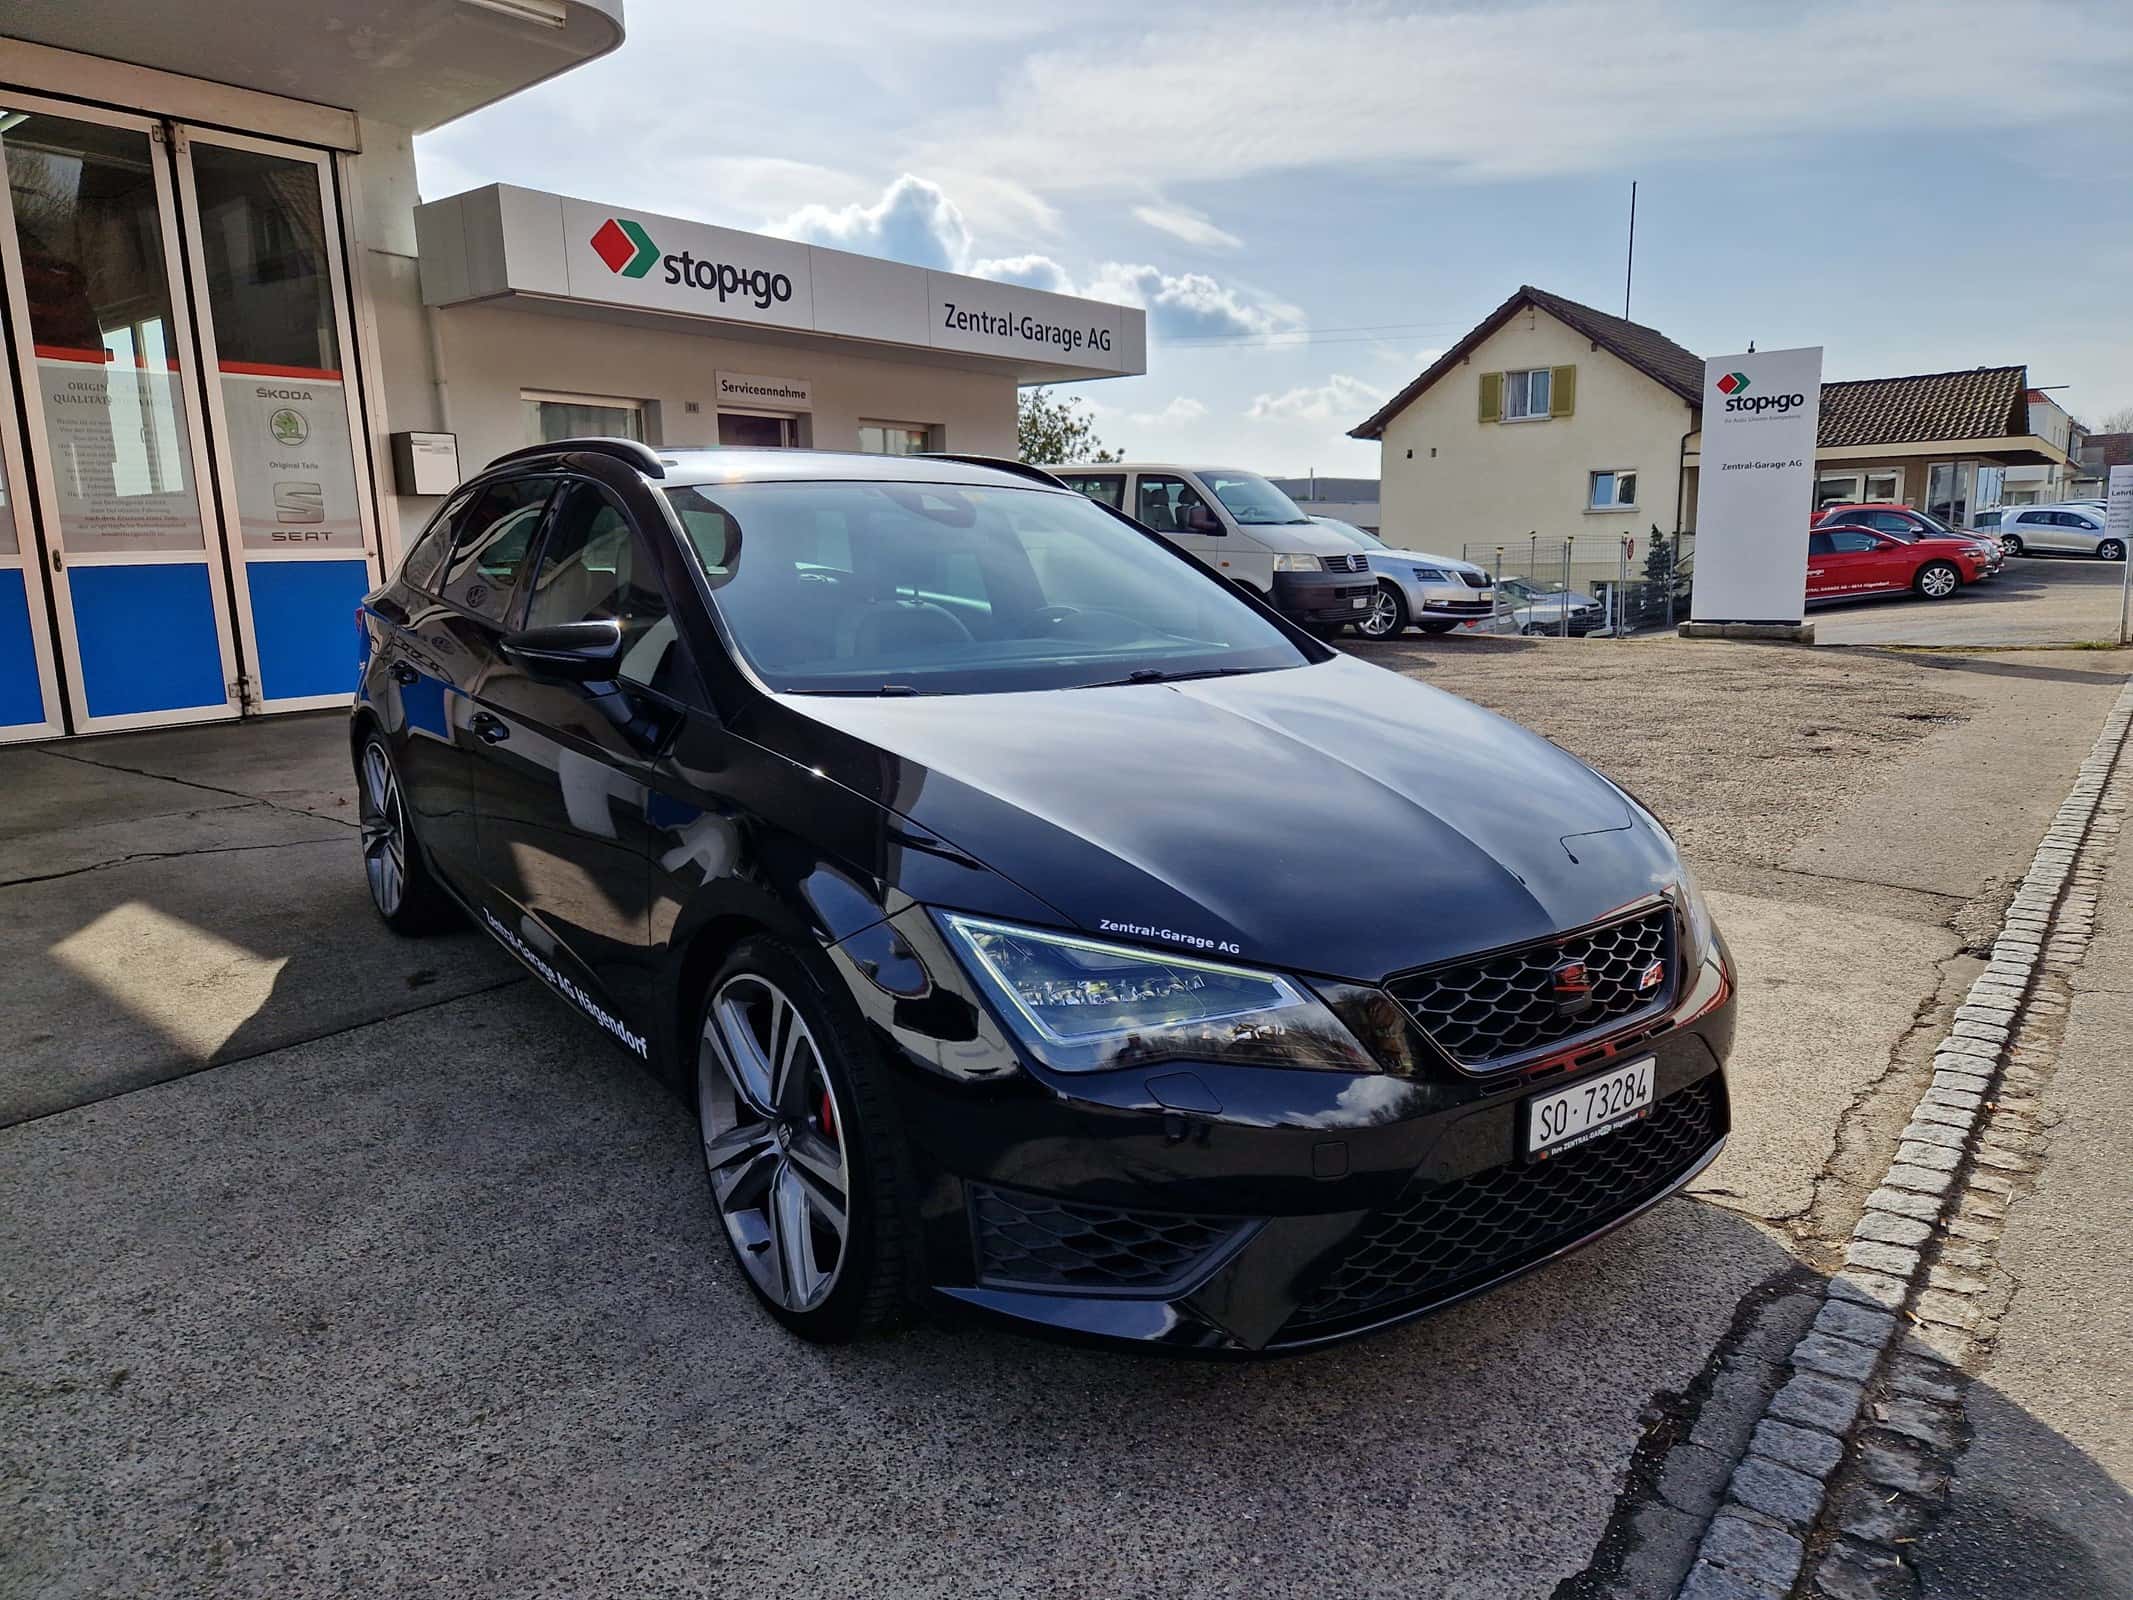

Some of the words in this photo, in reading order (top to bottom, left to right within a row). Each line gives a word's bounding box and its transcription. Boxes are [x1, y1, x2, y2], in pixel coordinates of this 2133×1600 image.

[663, 251, 792, 308] stop+go
[944, 303, 1082, 352] Zentral-Garage
[1087, 327, 1111, 351] AG
[256, 386, 313, 401] ŠKODA
[721, 379, 806, 399] Serviceannahme
[1725, 394, 1804, 414] stop+go
[1721, 461, 1786, 471] Zentral-Garage
[1788, 459, 1802, 468] AG
[271, 531, 333, 542] SEAT
[1100, 919, 1214, 949] Zentral-Garage
[1218, 941, 1240, 955] AG
[574, 985, 648, 1060] Hägendorf
